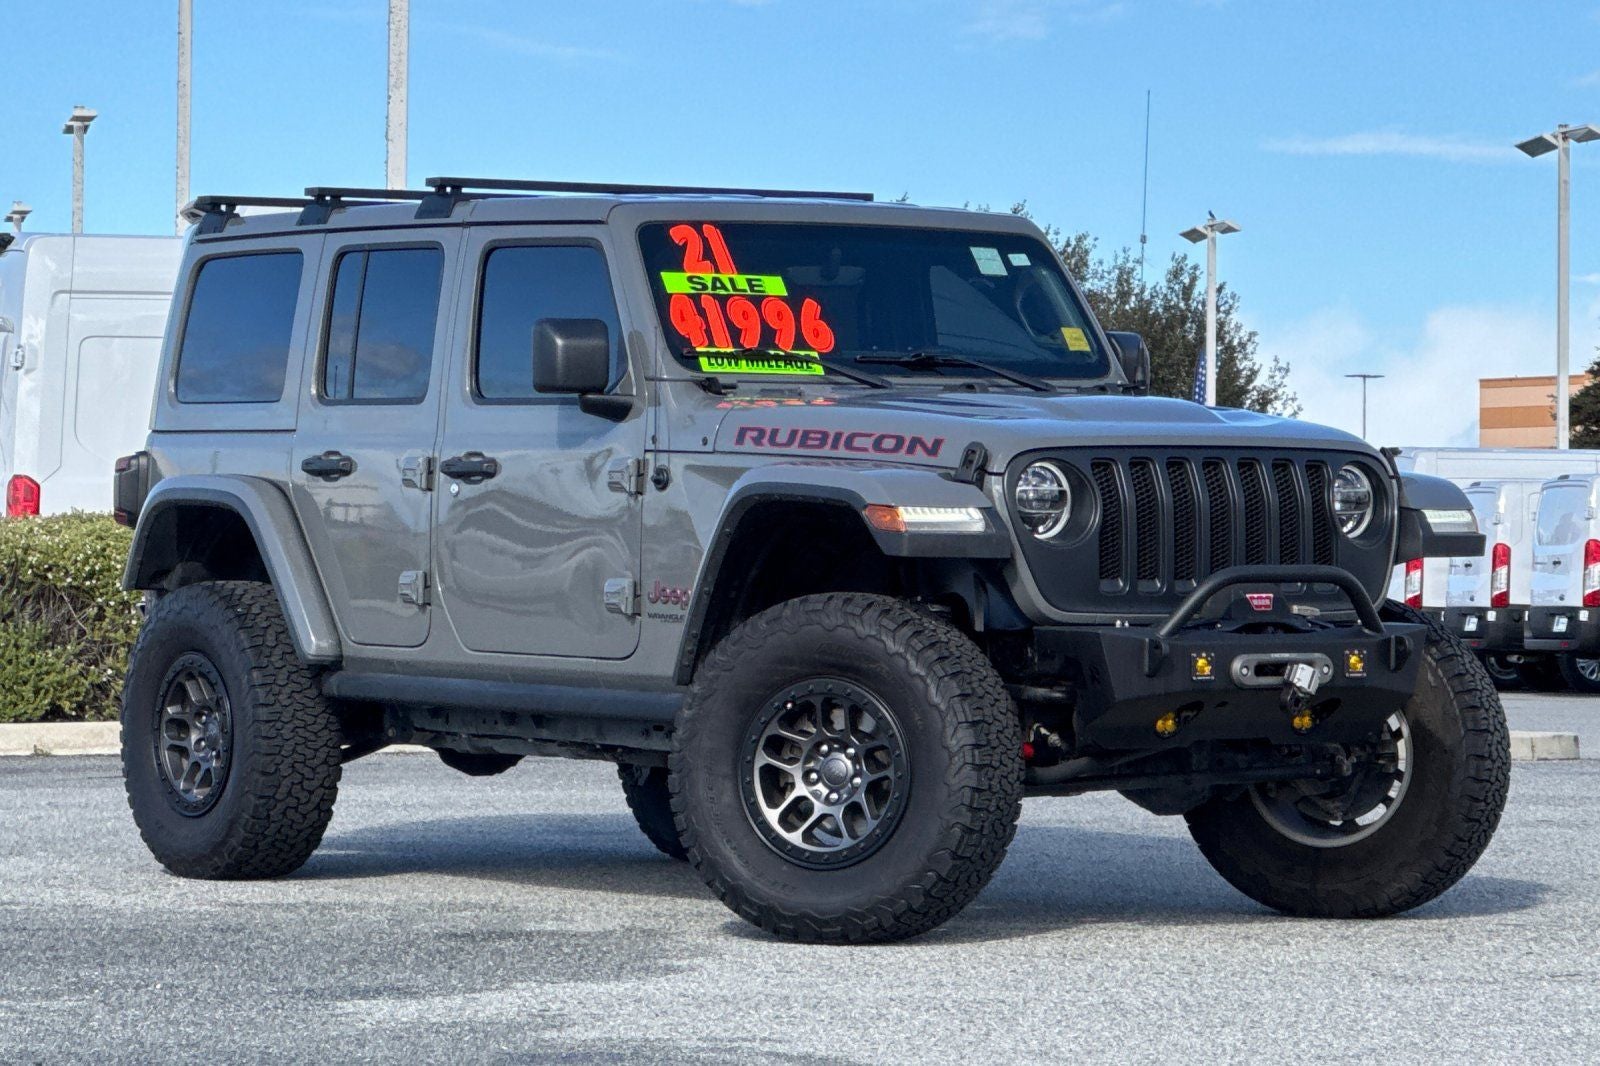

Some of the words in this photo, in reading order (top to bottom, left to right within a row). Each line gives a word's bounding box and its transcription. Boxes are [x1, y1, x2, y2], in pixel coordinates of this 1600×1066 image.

[669, 224, 738, 274] 21
[688, 275, 766, 293] SALE
[669, 294, 835, 353] 41996
[706, 354, 742, 368] LOW
[745, 355, 815, 371] MILEAGE
[735, 426, 944, 457] RUBICON
[648, 579, 692, 610] Jeep
